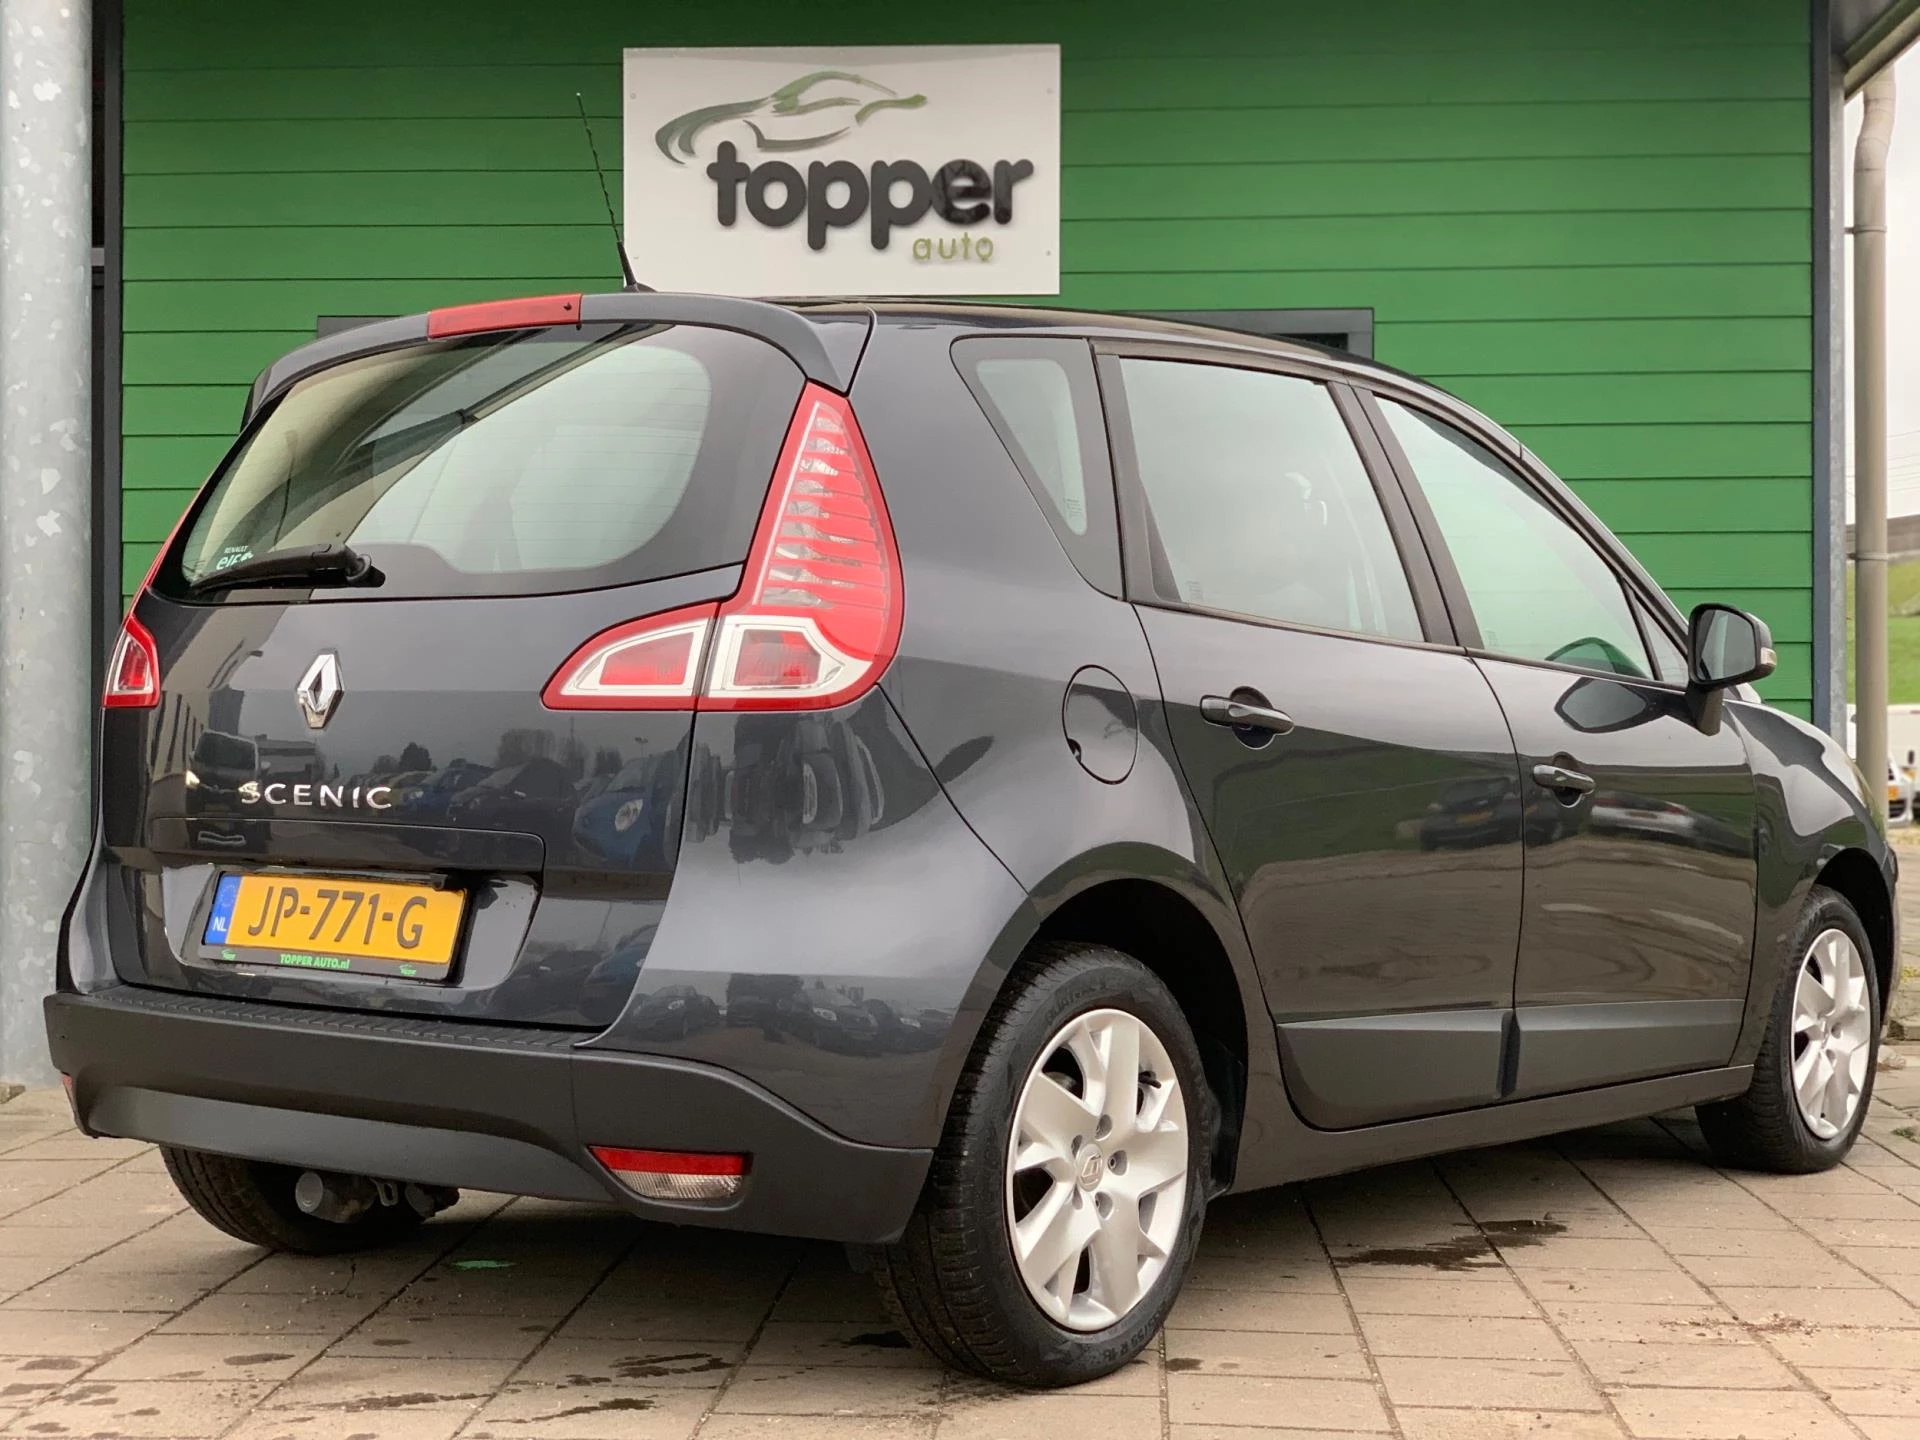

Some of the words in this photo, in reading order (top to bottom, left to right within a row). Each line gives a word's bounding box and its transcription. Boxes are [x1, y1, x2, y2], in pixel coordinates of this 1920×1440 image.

[706, 140, 1034, 251] topper
[912, 232, 994, 261] auto
[238, 780, 392, 810] SCENIC
[212, 916, 227, 932] NL
[248, 886, 427, 949] JP-771-G
[280, 953, 313, 966] TOPPER
[313, 956, 350, 970] AUTO.nl
